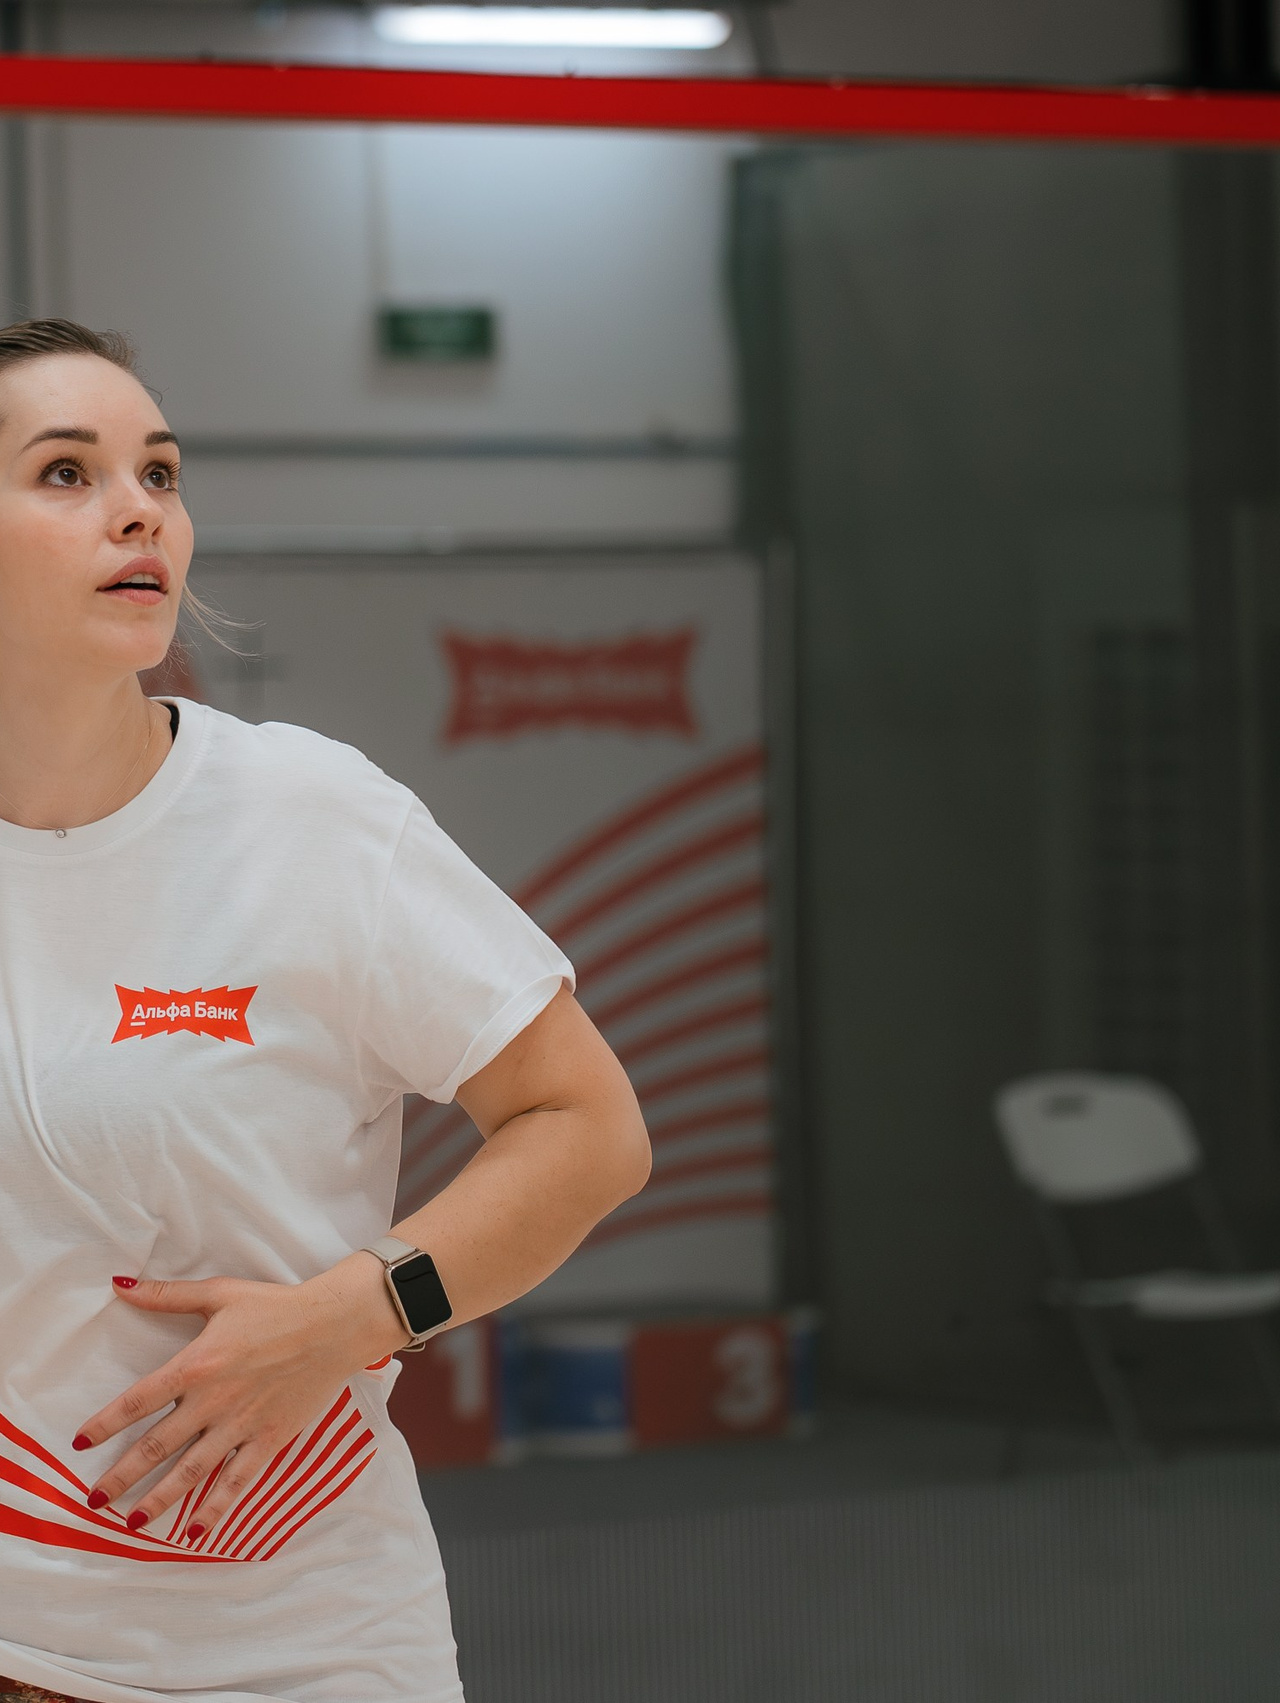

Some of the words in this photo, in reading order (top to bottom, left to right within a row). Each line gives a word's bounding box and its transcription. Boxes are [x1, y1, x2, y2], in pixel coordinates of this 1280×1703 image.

[131, 1002, 192, 1022] Альфа
[194, 1001, 239, 1021] Банк
[715, 1328, 778, 1429] 3
